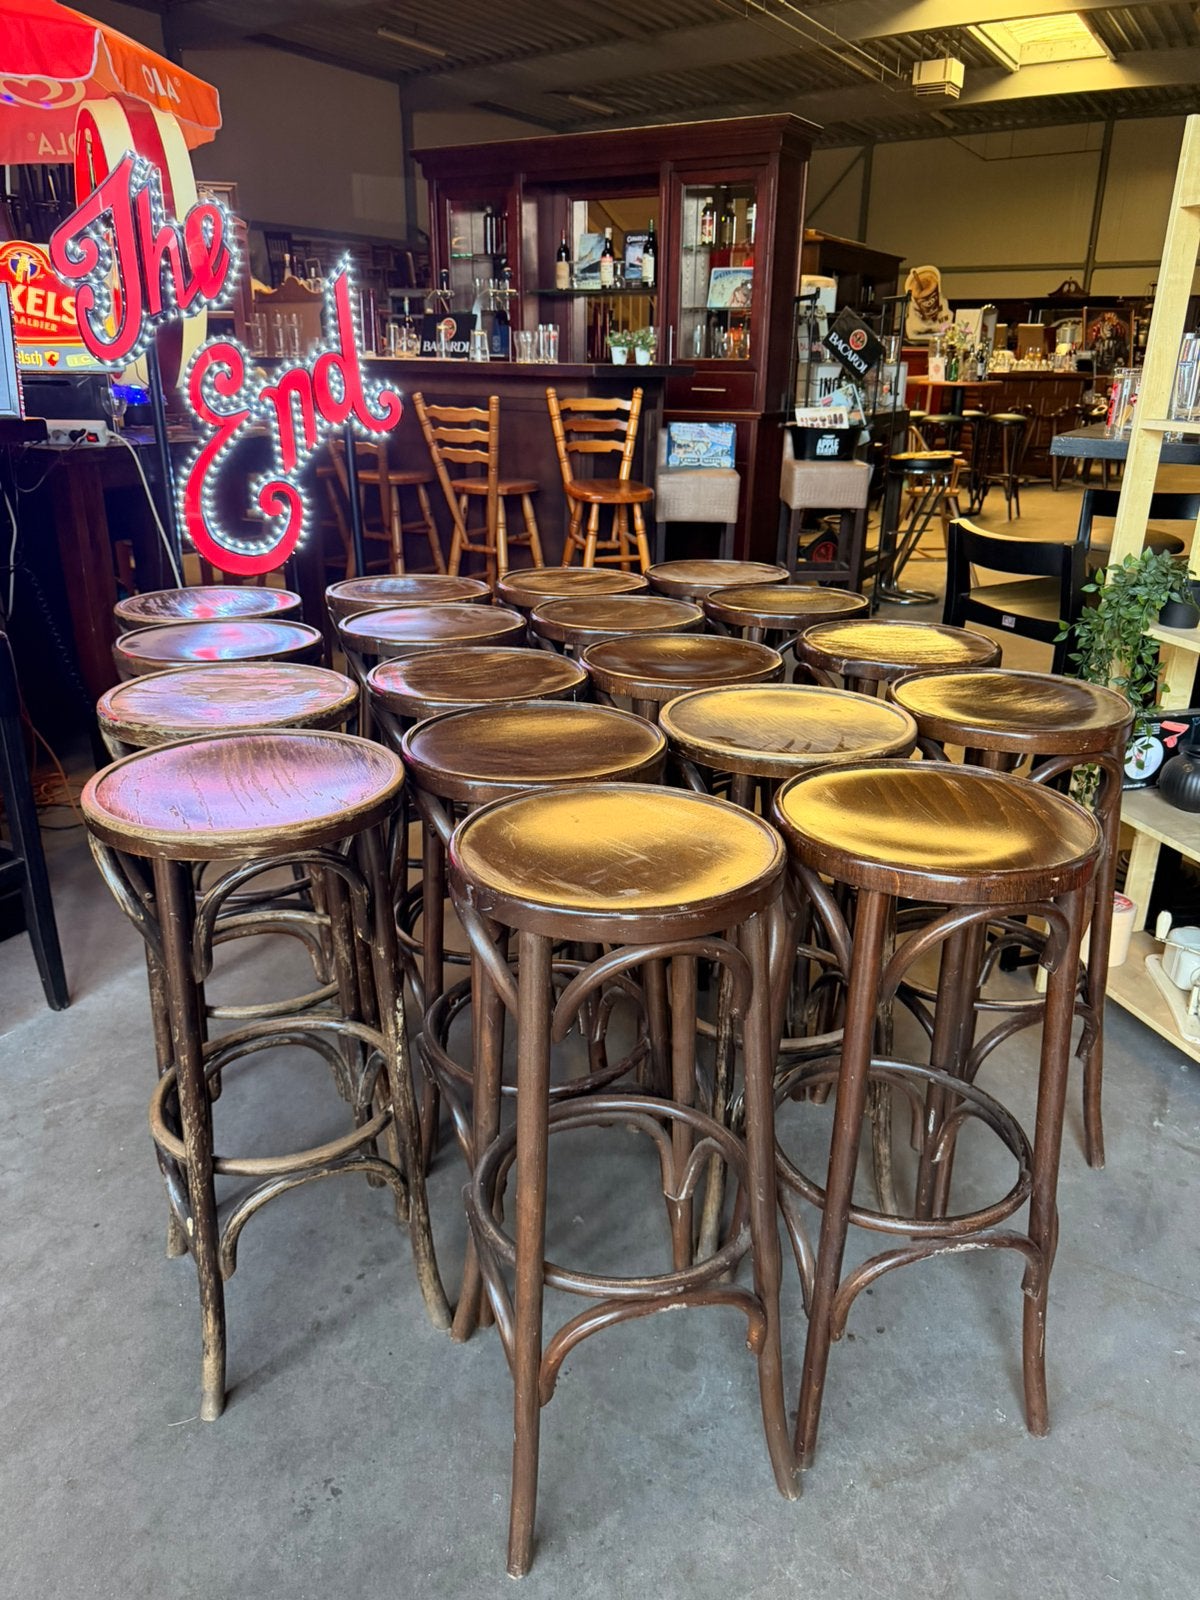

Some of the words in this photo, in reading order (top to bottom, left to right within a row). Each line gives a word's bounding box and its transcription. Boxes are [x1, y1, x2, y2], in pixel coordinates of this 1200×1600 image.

[51, 152, 234, 364] The
[828, 332, 869, 374] BACARDI
[180, 260, 405, 577] End
[817, 438, 840, 448] APPLE
